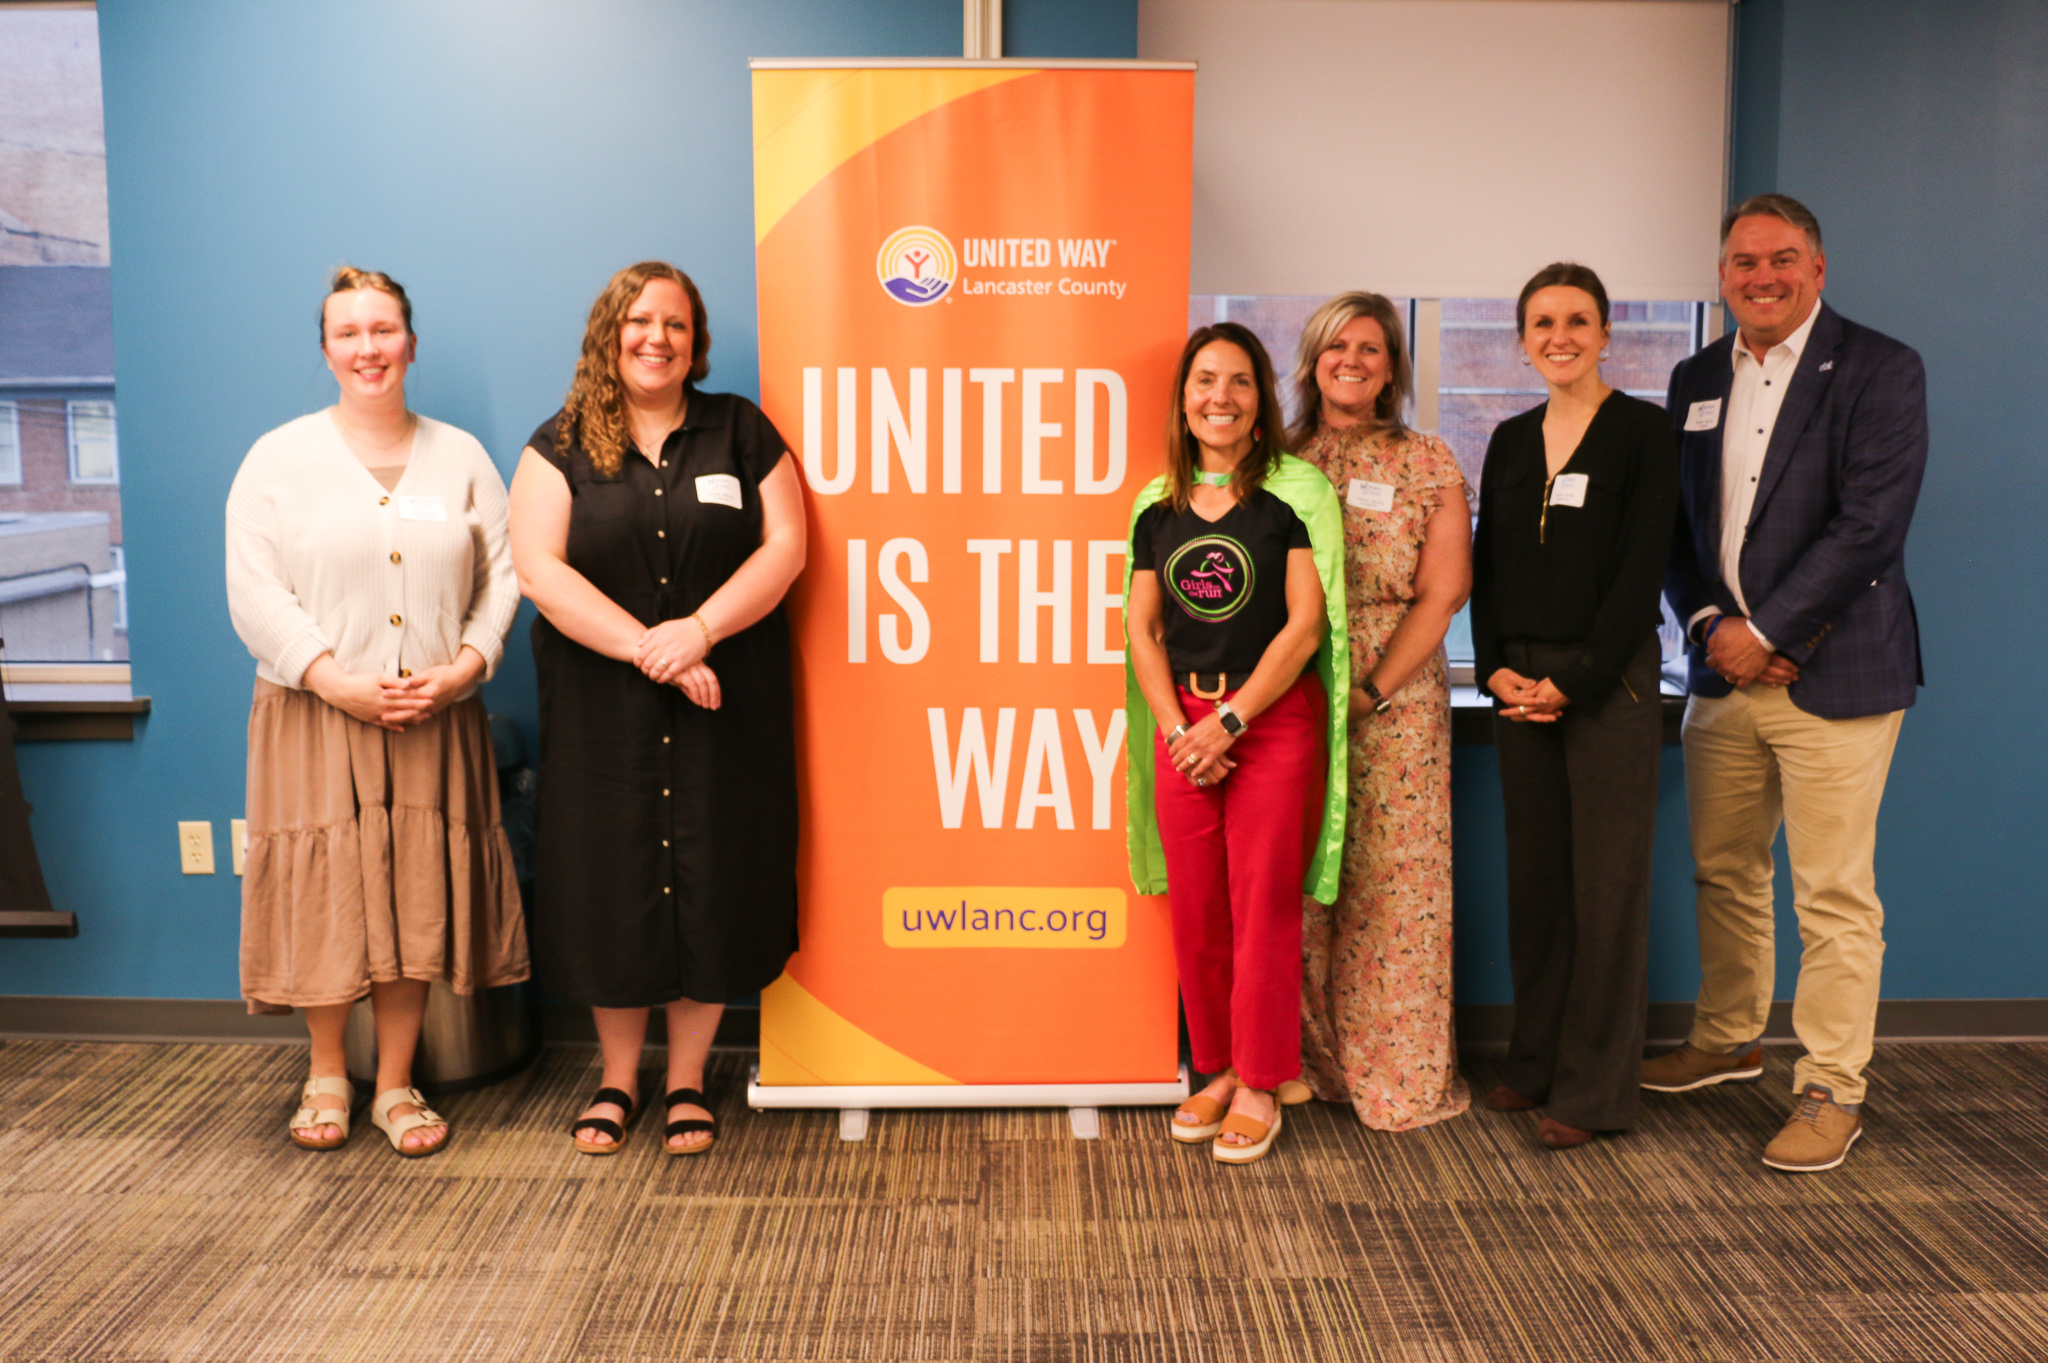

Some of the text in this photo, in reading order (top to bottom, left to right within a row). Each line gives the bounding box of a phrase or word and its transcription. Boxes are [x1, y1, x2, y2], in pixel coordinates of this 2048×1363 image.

[963, 238, 1111, 268] UNITED WAY
[963, 278, 1127, 300] Lancaster County
[803, 367, 1128, 496] UNITED
[847, 537, 1128, 665] IS THE
[1180, 579, 1213, 590] Girls
[1198, 590, 1222, 598] run
[926, 707, 1128, 830] WAY
[902, 900, 1107, 941] uwlanc.org
